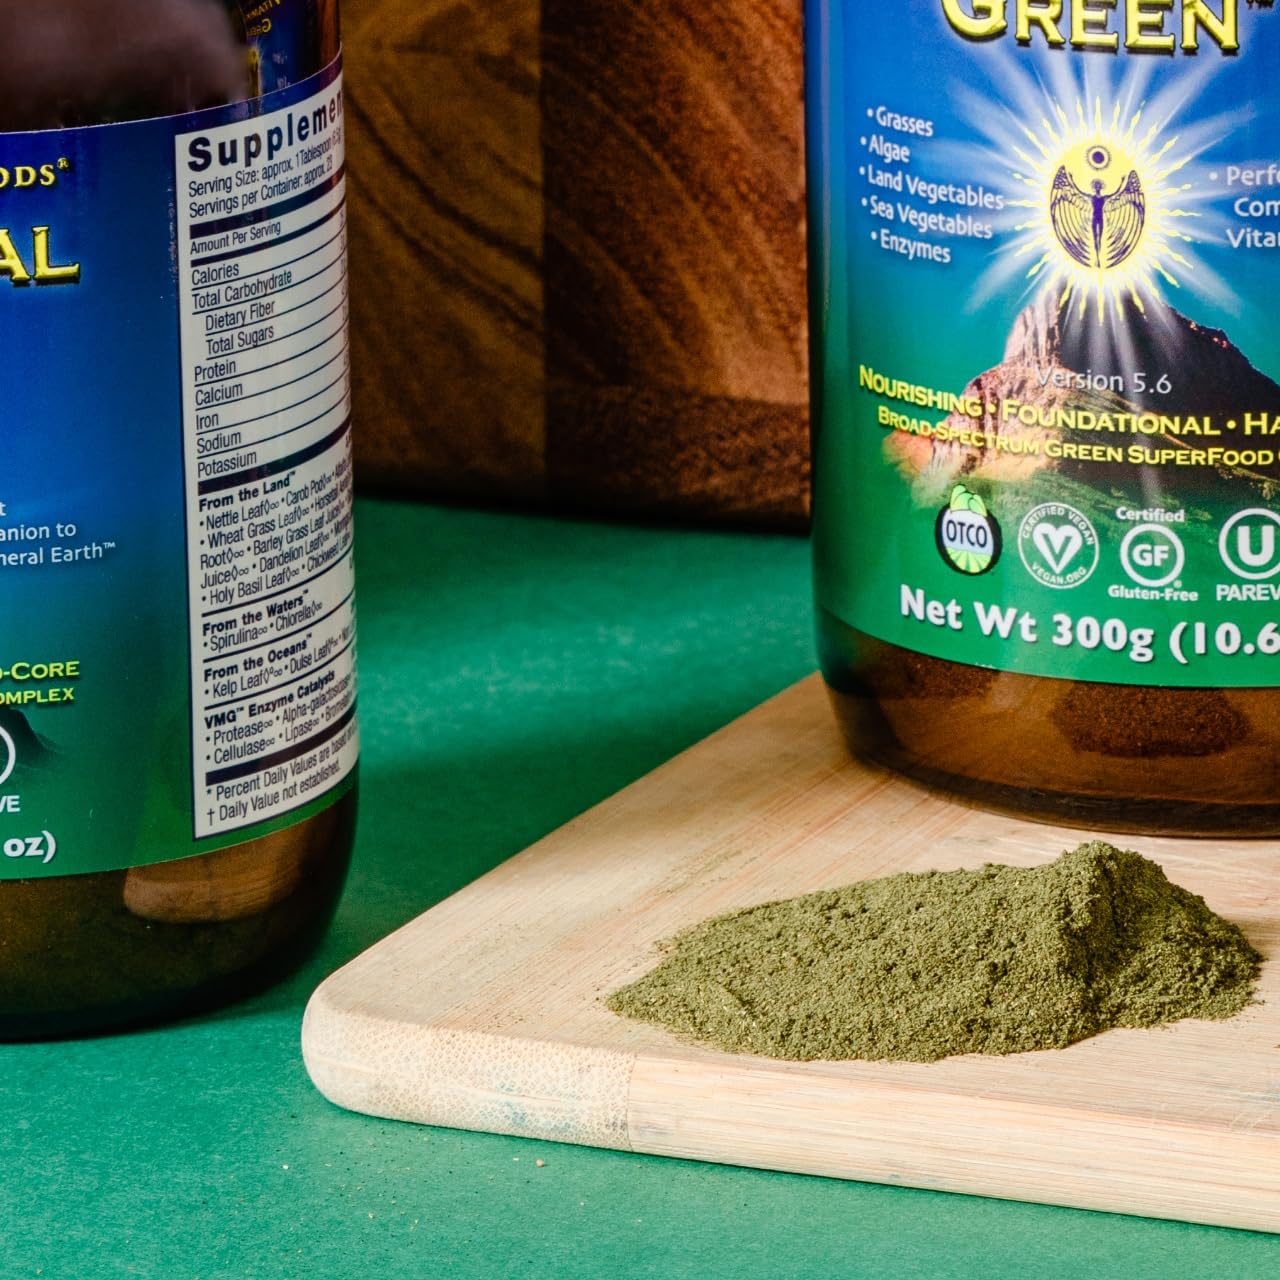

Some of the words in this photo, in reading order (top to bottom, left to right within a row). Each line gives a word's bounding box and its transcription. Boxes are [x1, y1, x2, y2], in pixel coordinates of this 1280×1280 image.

[877, 105, 934, 138] Grasses
[868, 135, 910, 164] Algae
[189, 176, 232, 197] Serving
[236, 170, 260, 187] Size:
[262, 158, 293, 180] approx.
[867, 164, 902, 192] Land
[906, 176, 1005, 211] Vegetables
[189, 197, 238, 218] Servings
[242, 189, 258, 209] per
[869, 195, 897, 220] Sea
[900, 203, 993, 240] Vegetables
[190, 232, 231, 255] Amount
[232, 228, 248, 244] Per
[250, 220, 281, 240] Serving
[879, 228, 951, 264] Enzymes
[192, 264, 239, 286] Calories
[192, 291, 220, 309] Total
[224, 270, 292, 303] Carbohydrate
[206, 311, 247, 332] Dietary
[250, 300, 275, 319] Fiber
[206, 336, 233, 355] Total
[238, 325, 274, 349] Sugars
[194, 360, 236, 382] Protein
[1034, 365, 1124, 392] Version
[1133, 372, 1173, 395] 5.6
[195, 382, 243, 406] Calcium
[859, 365, 982, 417] NOURISHING
[1001, 399, 1221, 436] FOUNDATIONAL
[196, 413, 219, 430] Iron
[878, 405, 1040, 455] BROAD-SPECTRUM
[1044, 438, 1124, 463] GREEN
[1127, 445, 1274, 467] SUPERFOOD
[197, 430, 242, 454] Sodium
[198, 451, 257, 478] Potassium
[199, 494, 234, 513] From
[238, 486, 259, 502] the
[1116, 506, 1185, 522] Certified
[57, 522, 76, 537] to
[206, 509, 239, 531] Nettle
[207, 527, 244, 550] Wheat
[247, 518, 276, 540] Grass
[947, 521, 988, 548] OTCO
[1022, 507, 1066, 539] CERTIFIED
[1067, 508, 1094, 546] VEGAN
[253, 535, 283, 556] Barley
[285, 523, 309, 544] Grass
[1237, 525, 1275, 566] U
[259, 546, 304, 573] Dandelion
[1133, 544, 1169, 567] GF
[1031, 561, 1087, 586] VEGAN.ORG
[210, 586, 235, 605] Holy
[238, 579, 263, 598] Basil
[1108, 584, 1199, 602] Gluten-Free
[203, 619, 238, 637] From
[242, 609, 263, 626] the
[900, 583, 963, 630] Net
[973, 600, 1038, 644] Wt
[1052, 613, 1155, 661] 300g
[204, 665, 239, 682] From
[243, 654, 263, 671] the
[212, 679, 238, 699] Kelp
[248, 691, 295, 718] Enzyme
[297, 669, 336, 700] Catalysts
[216, 777, 261, 802] Percent
[264, 767, 289, 788] Daily
[290, 753, 317, 776] Values
[219, 800, 249, 821] Daily
[251, 790, 280, 812] Value
[282, 783, 298, 802] not
[4, 830, 56, 863] oz)
